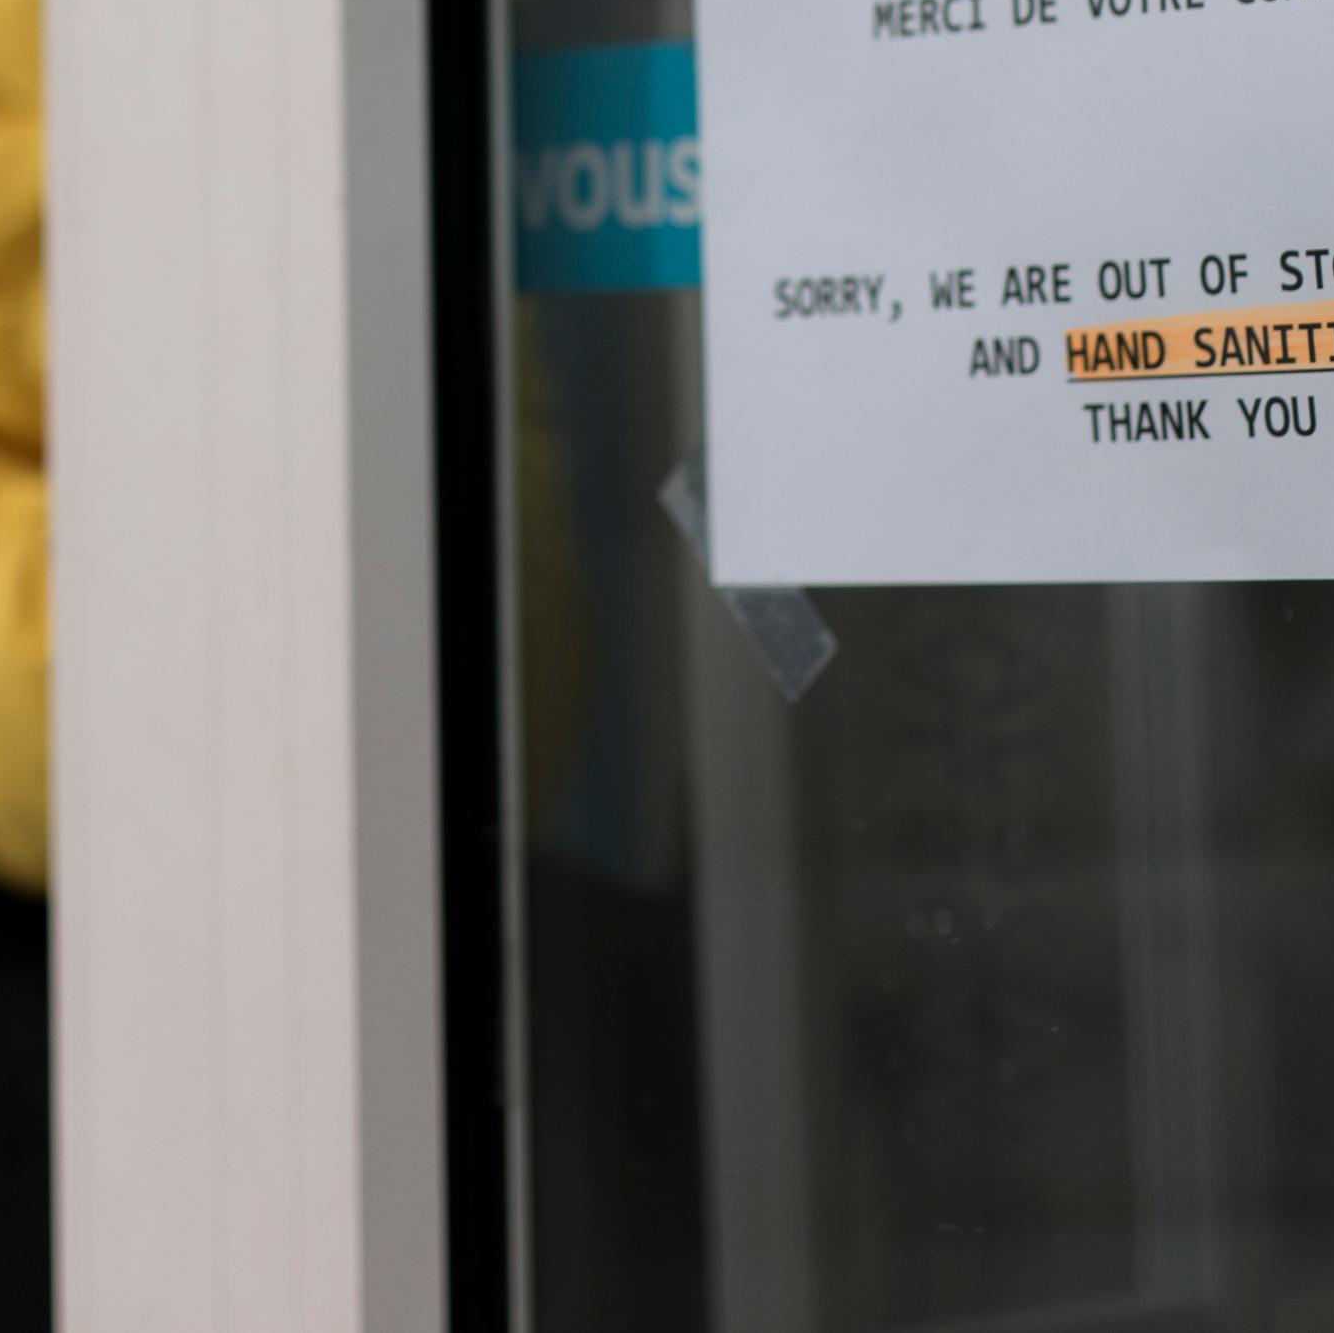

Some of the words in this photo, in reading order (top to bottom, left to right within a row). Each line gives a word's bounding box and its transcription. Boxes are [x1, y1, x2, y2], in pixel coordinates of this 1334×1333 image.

[775, 275, 902, 321] SORRY,
[930, 268, 974, 309] WE
[1002, 263, 1071, 304] ARE
[1098, 258, 1171, 301] OUT
[1200, 253, 1248, 296] OF
[970, 336, 1040, 376] AND
[1066, 330, 1167, 379] HAND
[1084, 399, 1210, 442] THANK
[1237, 395, 1317, 438] YOU
